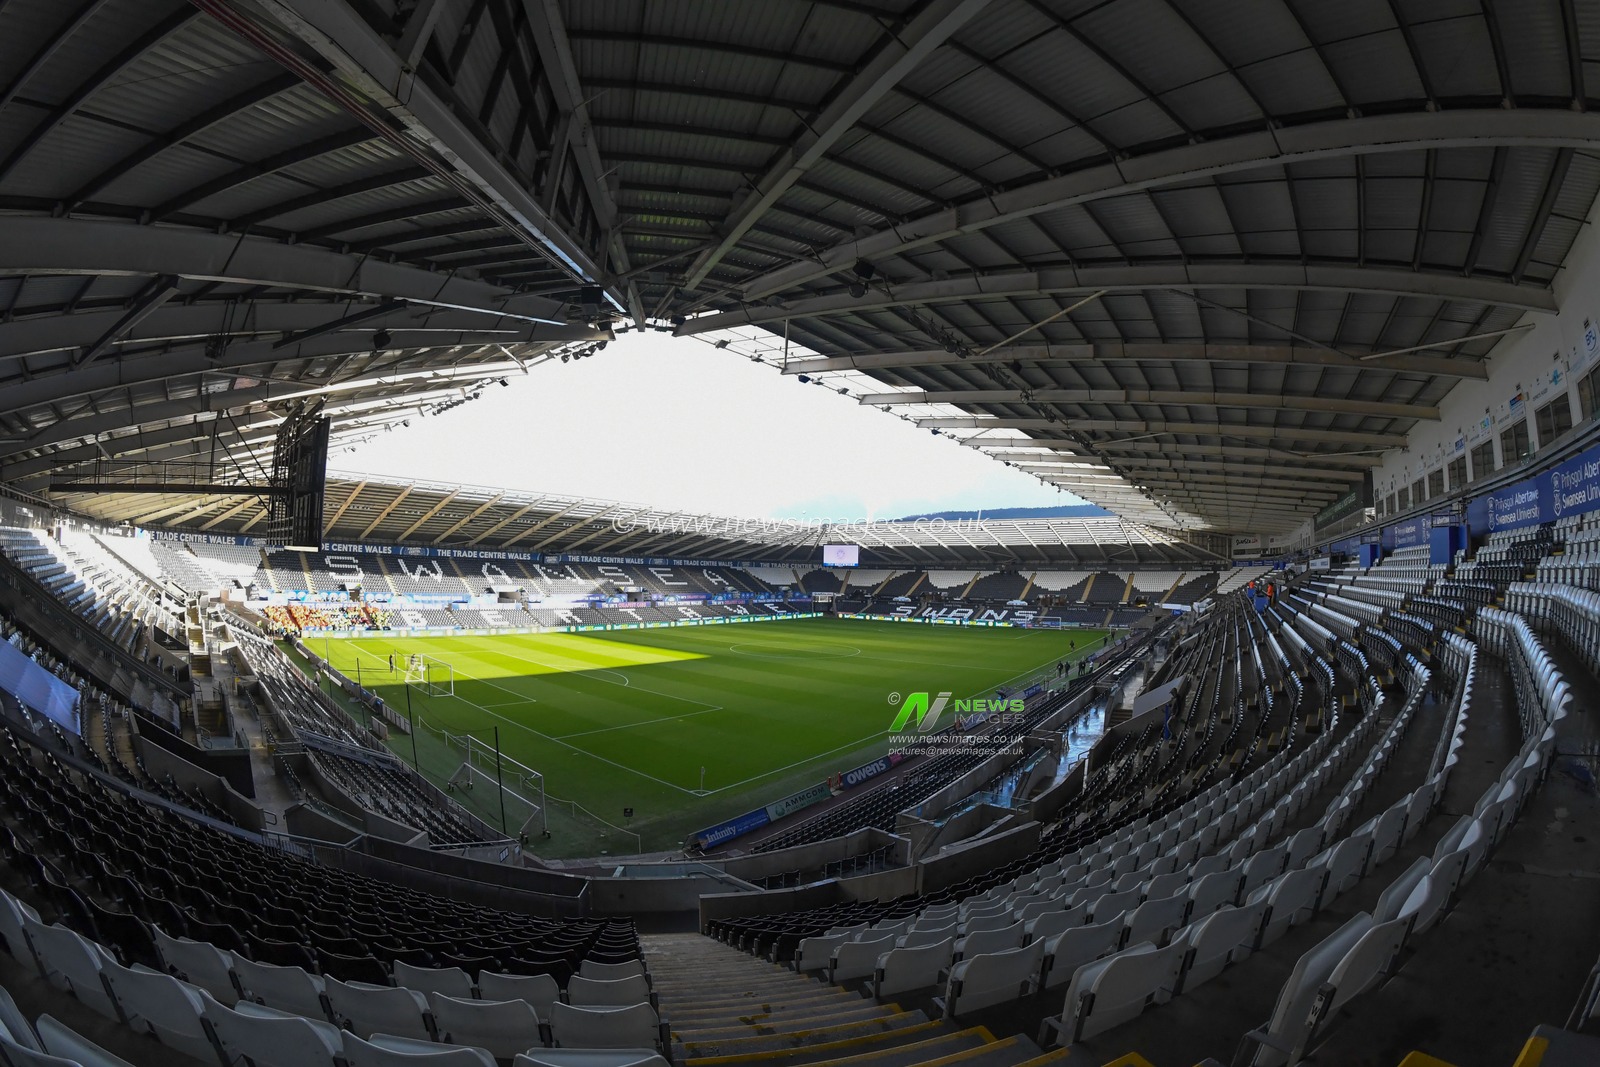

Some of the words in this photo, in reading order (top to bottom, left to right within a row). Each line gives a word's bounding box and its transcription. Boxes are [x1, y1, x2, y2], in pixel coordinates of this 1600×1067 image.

[1584, 458, 1600, 480] Aber
[1515, 489, 1539, 505] Abertawe
[1562, 490, 1586, 509] Swansea
[1495, 511, 1516, 526] Swansea
[1517, 504, 1540, 521] University
[156, 531, 178, 541] TRADE
[180, 533, 207, 543] CENTRE
[209, 535, 236, 545] WALES
[331, 543, 363, 553] CENTRE
[364, 545, 392, 555] WALES
[437, 549, 451, 557] THE
[453, 550, 477, 559] TRADE
[479, 551, 506, 560] CENTRE
[507, 552, 531, 561] WALES
[603, 556, 624, 564] CENTRE
[625, 557, 644, 565] WALES
[683, 559, 699, 567] TRADE
[889, 605, 1038, 622] SWANS
[785, 786, 825, 808] AMMCOM
[706, 825, 737, 843] Infinity
